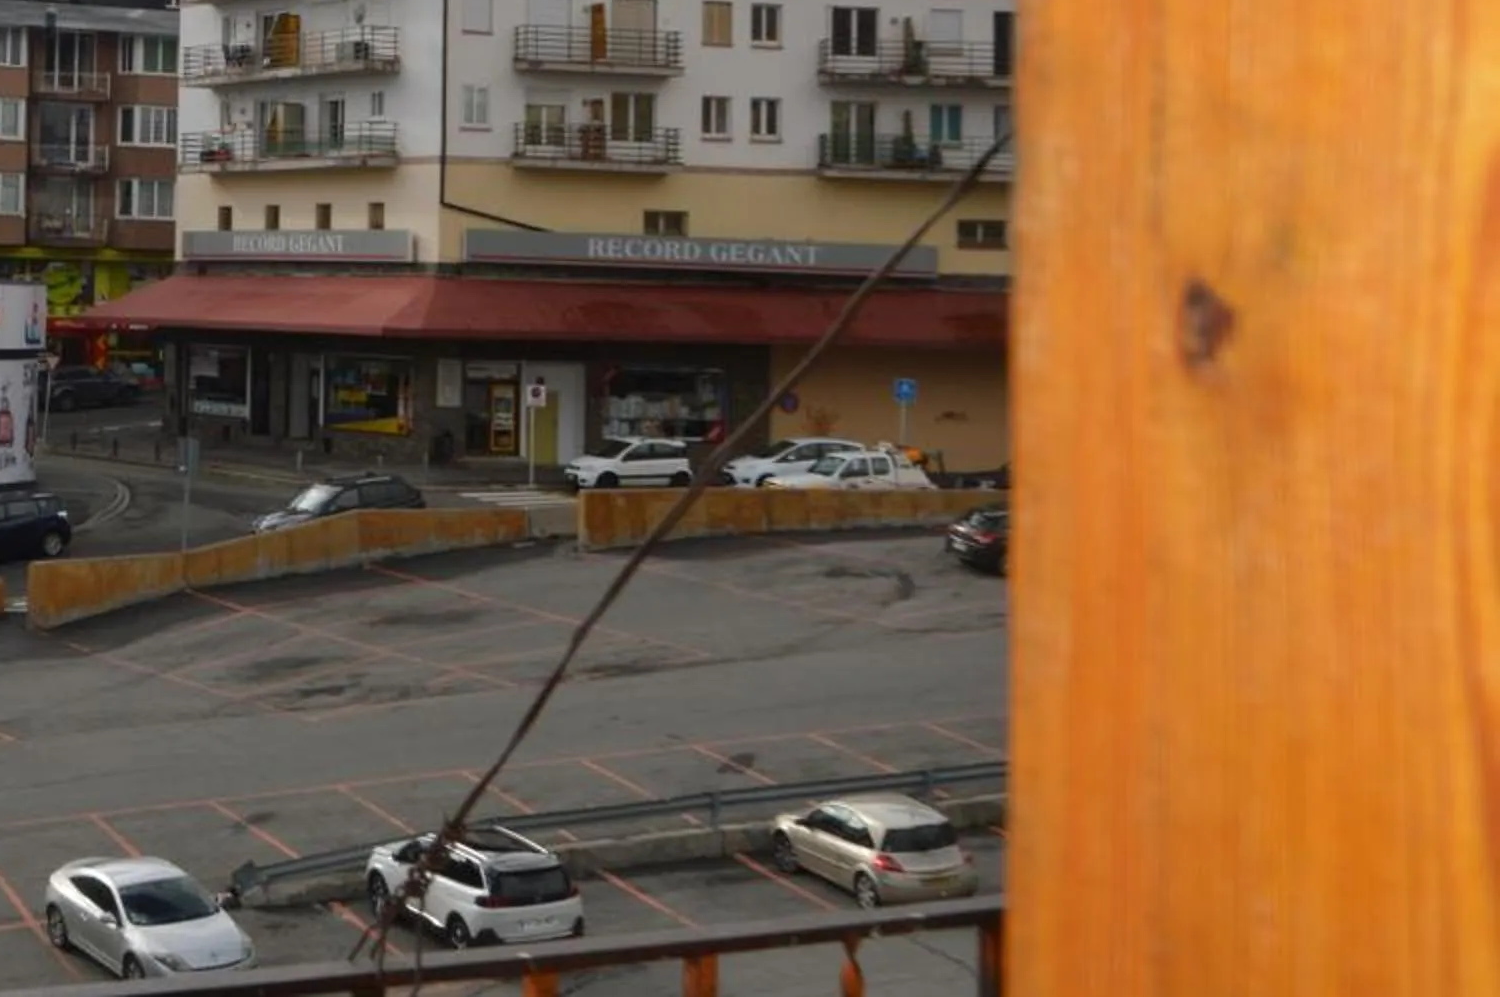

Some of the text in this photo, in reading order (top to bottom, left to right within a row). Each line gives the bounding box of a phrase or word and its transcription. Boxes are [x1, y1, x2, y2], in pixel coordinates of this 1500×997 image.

[233, 234, 344, 253] RECORD GEGANT
[588, 237, 819, 265] RECORD GEGANT
